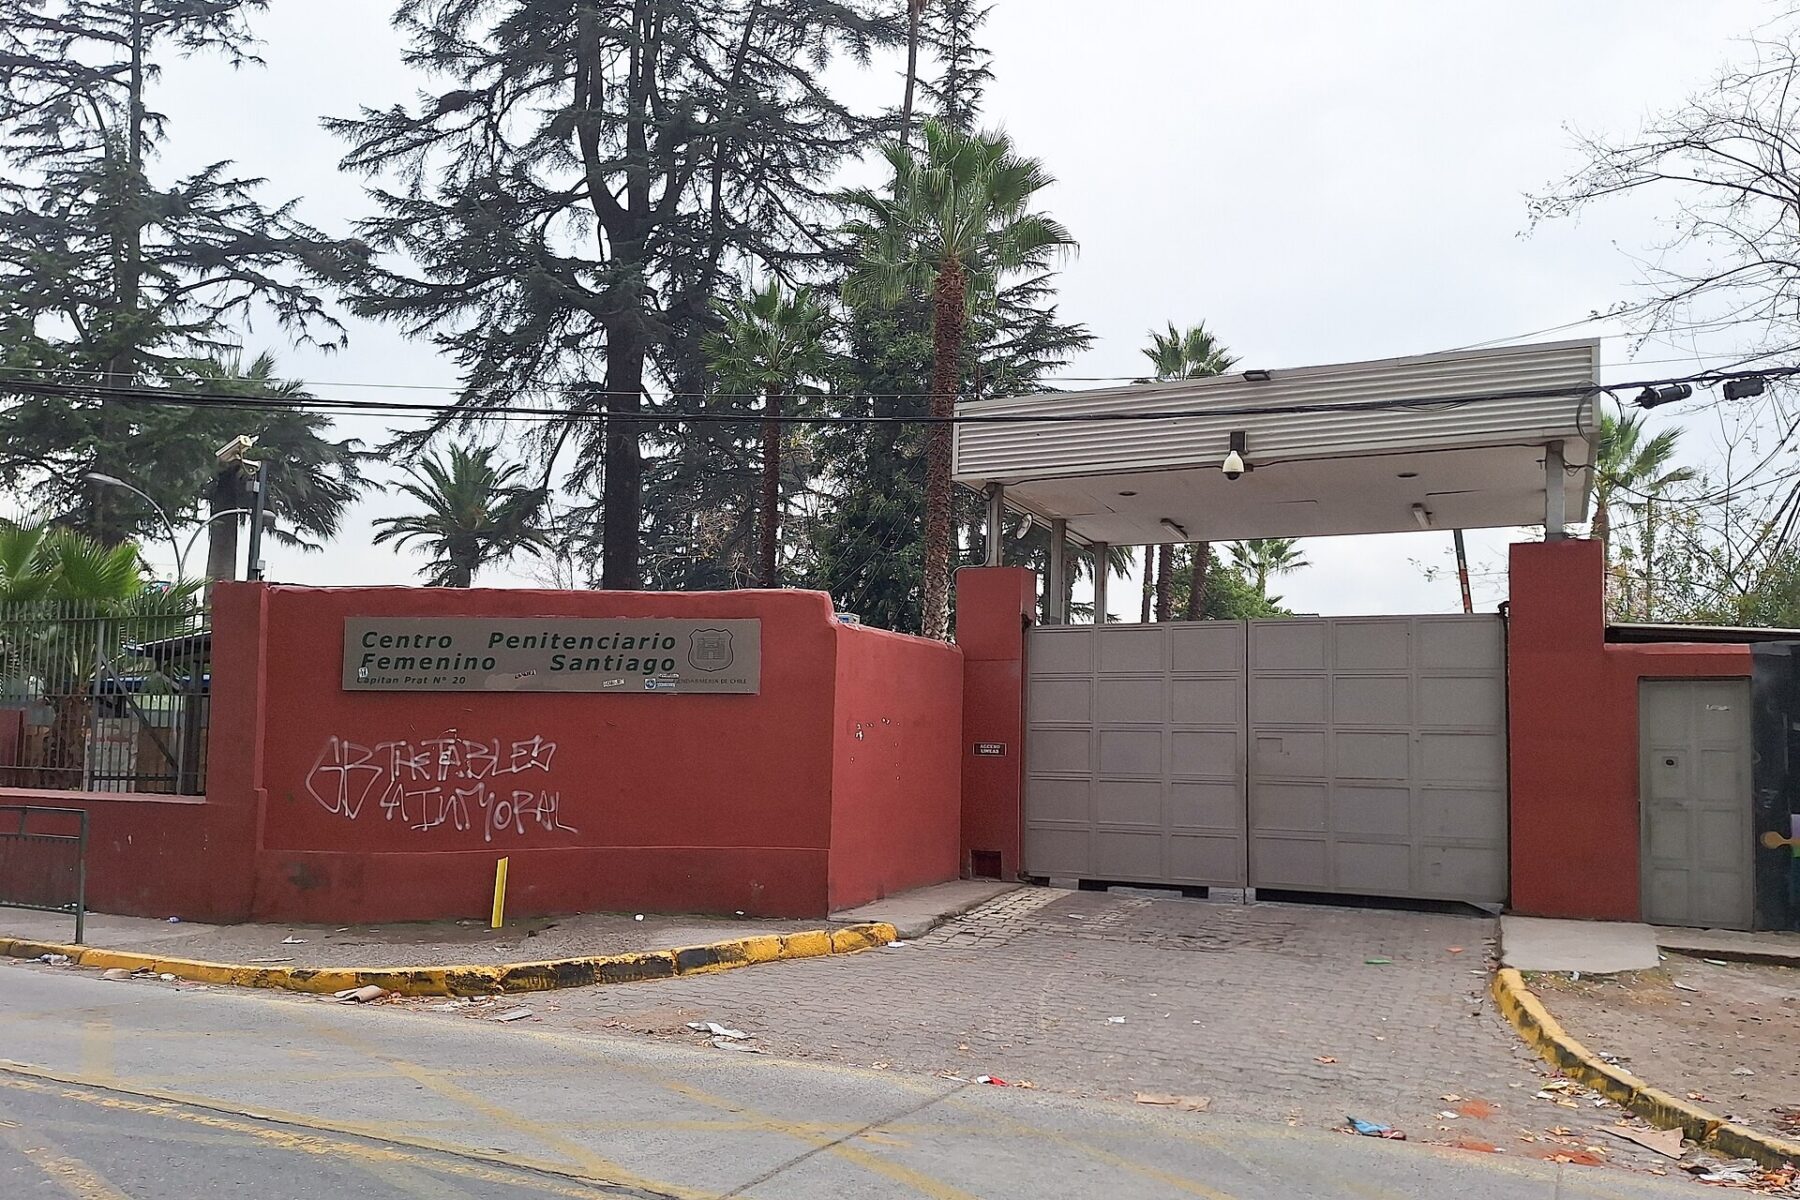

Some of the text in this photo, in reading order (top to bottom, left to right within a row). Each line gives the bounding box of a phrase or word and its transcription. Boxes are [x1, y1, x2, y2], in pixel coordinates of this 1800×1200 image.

[362, 631, 676, 650] Centro Penitenciario
[361, 653, 496, 670] Femenino
[550, 654, 675, 676] Santiago
[404, 676, 428, 684] Prat
[452, 676, 466, 684] 20
